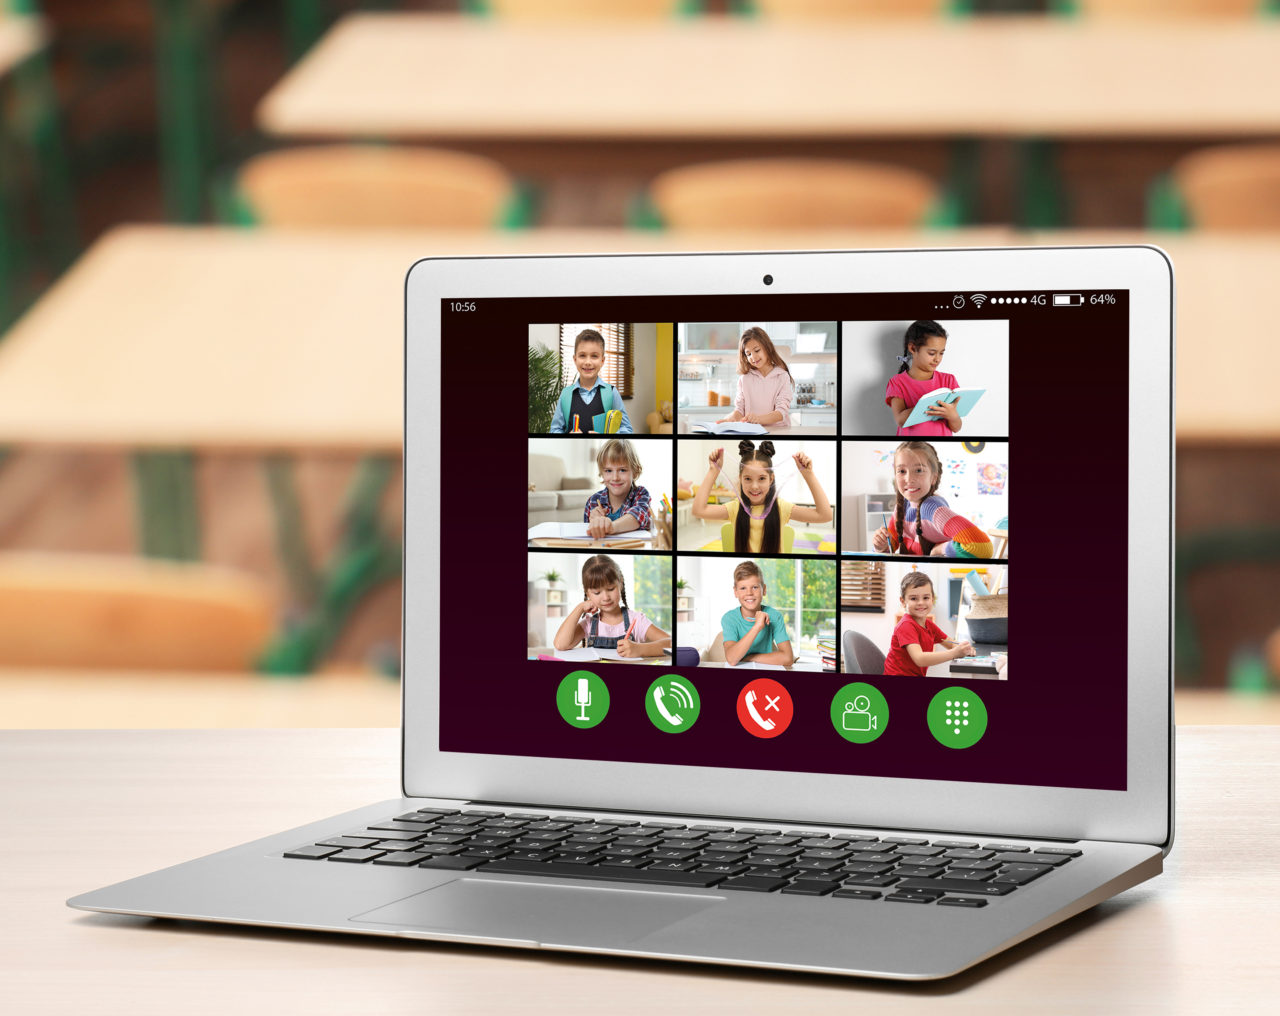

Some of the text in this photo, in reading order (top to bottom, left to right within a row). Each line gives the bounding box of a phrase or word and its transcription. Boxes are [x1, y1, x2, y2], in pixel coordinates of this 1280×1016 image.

[1030, 293, 1116, 305] 4G 64%
[450, 302, 476, 312] 10:56
